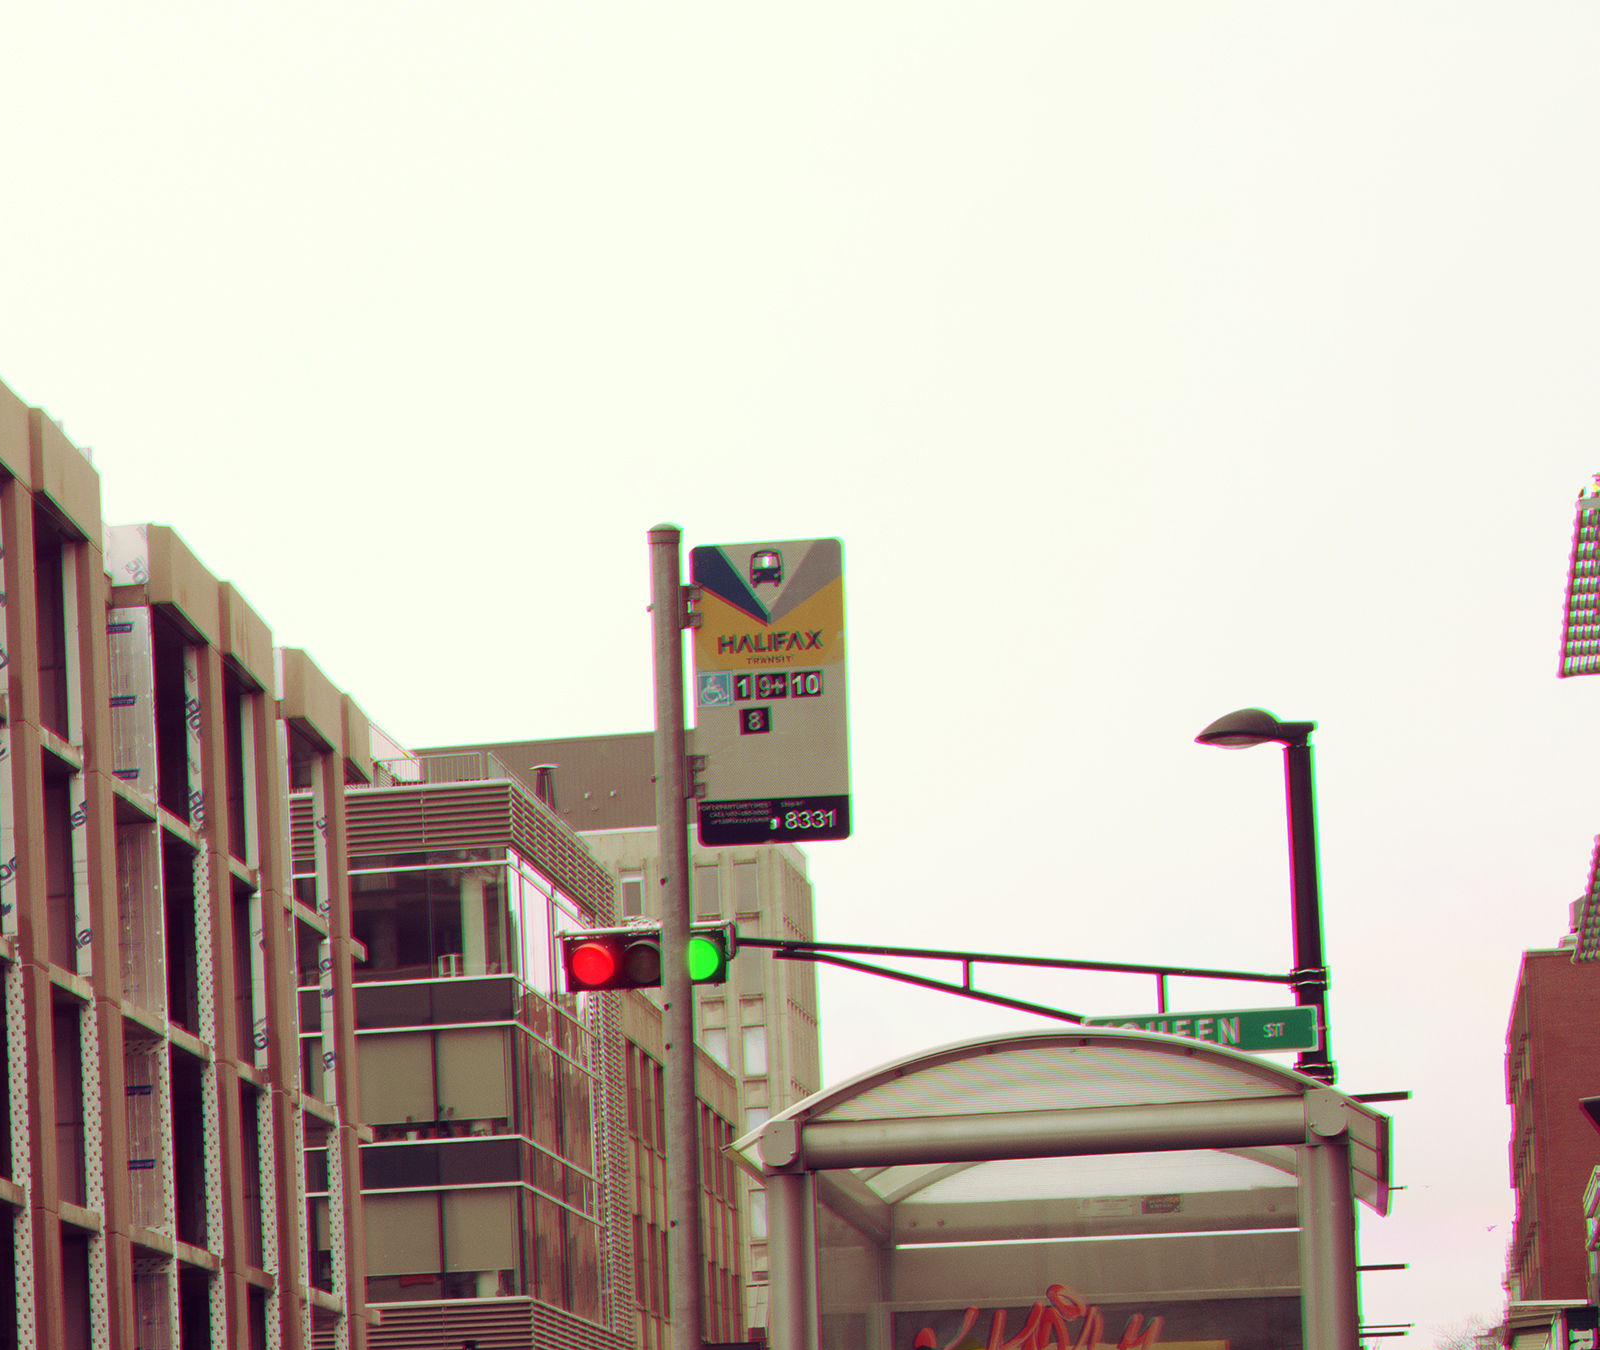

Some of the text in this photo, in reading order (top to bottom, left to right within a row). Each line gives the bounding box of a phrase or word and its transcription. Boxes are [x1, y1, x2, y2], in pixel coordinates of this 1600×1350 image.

[717, 629, 824, 655] HALIFAX
[746, 653, 796, 665] TRANSIT
[792, 672, 822, 695] 10
[748, 709, 765, 731] 8
[785, 809, 836, 829] 8331
[1263, 1021, 1285, 1039] ST
